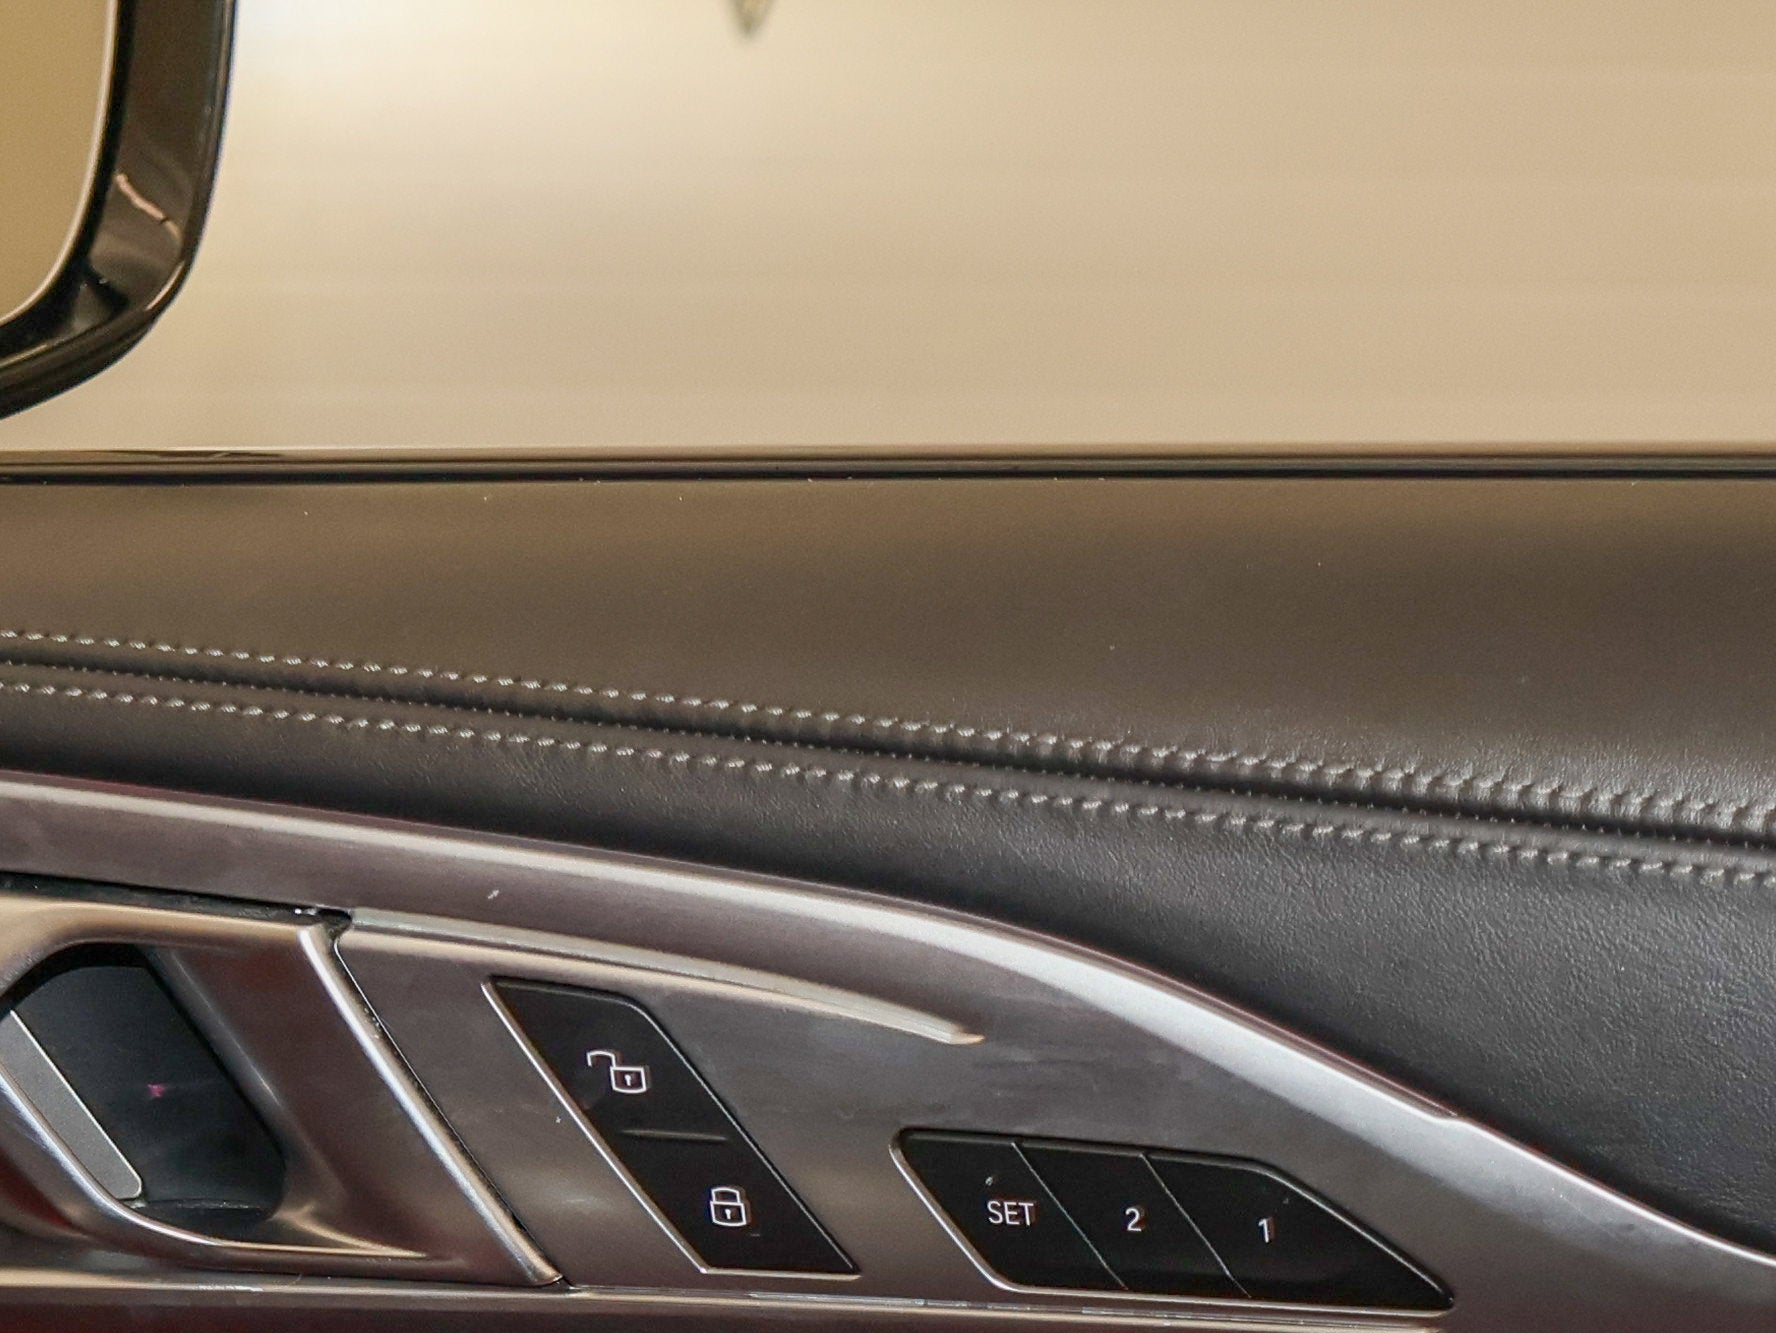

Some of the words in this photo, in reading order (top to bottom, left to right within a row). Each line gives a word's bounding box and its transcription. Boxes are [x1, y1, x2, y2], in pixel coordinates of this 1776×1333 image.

[987, 1201, 1035, 1227] SET
[1125, 1208, 1143, 1232] 2
[1258, 1218, 1271, 1244] 1
